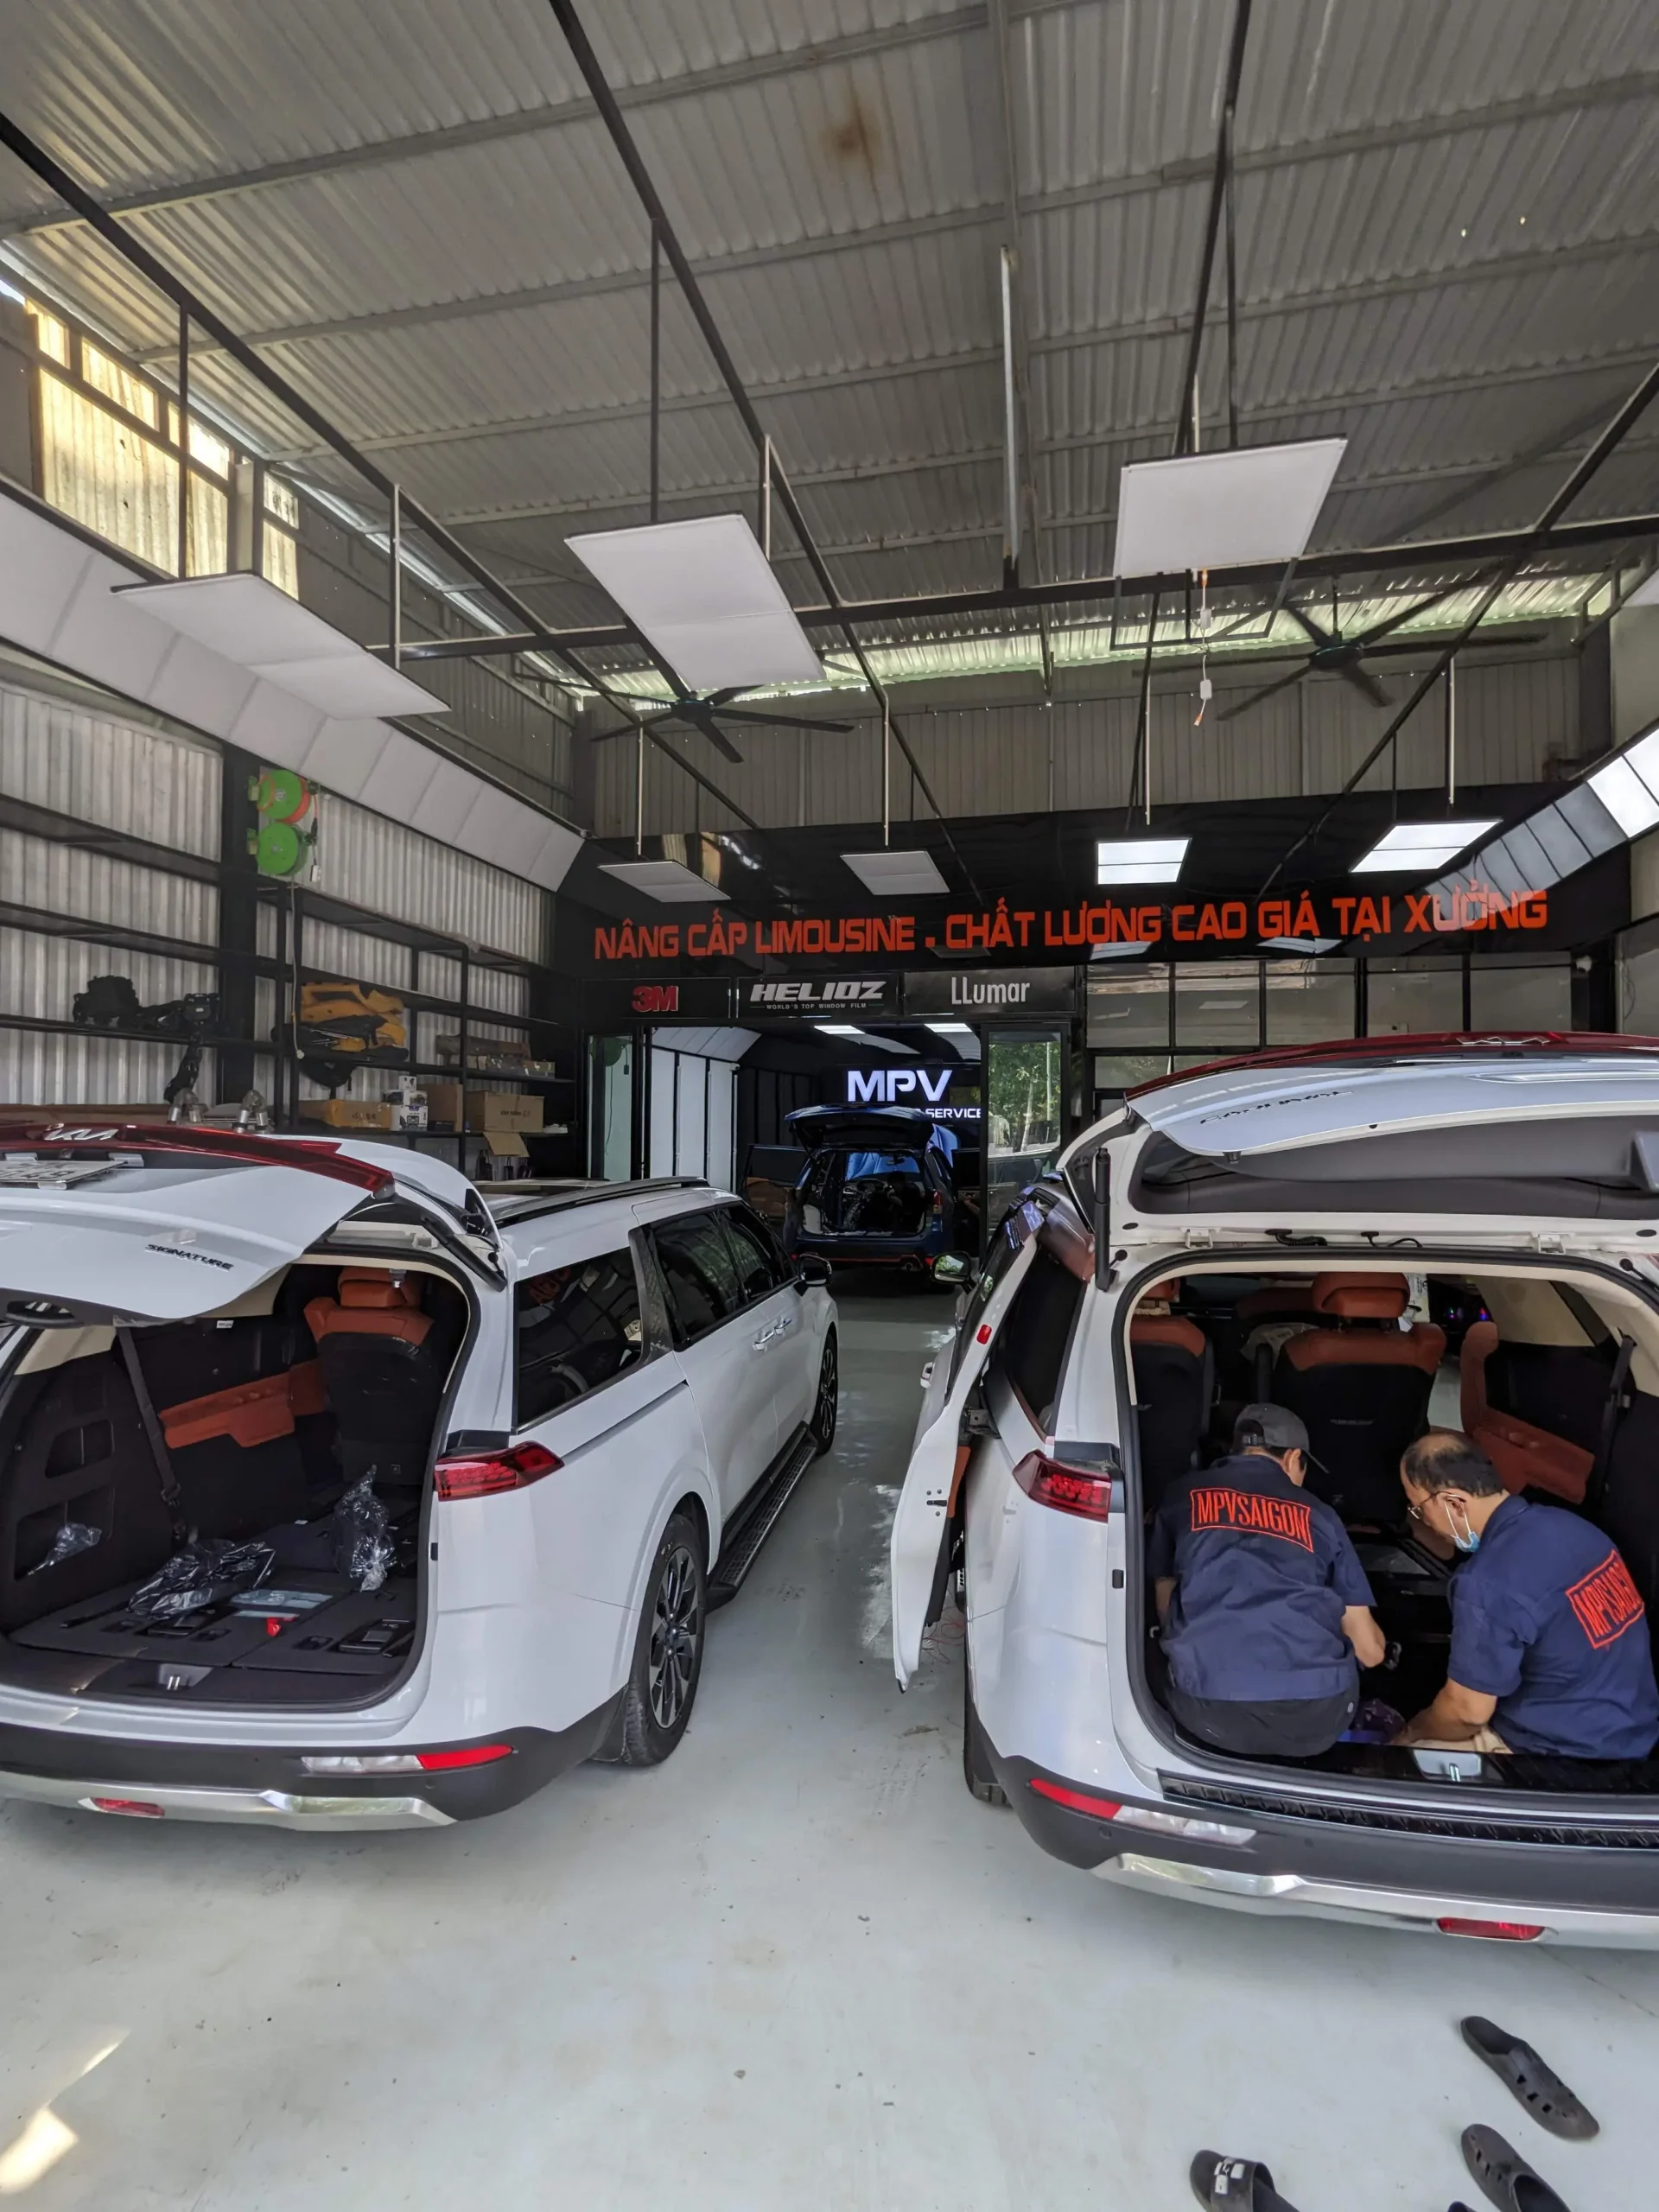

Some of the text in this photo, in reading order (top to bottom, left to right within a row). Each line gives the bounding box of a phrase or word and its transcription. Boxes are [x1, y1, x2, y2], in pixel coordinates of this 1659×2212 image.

[594, 918, 679, 960] NÂNG
[688, 907, 747, 957] CẤP
[755, 917, 915, 954] LIMOUSINE
[945, 896, 1036, 949] CHẤT
[1173, 901, 1247, 941] CAO
[1258, 889, 1320, 938] GIÁ
[1332, 896, 1391, 942] TẠI
[1403, 879, 1548, 932] XƯỞNG
[631, 985, 679, 1013] 3M
[749, 982, 887, 1002] HELIOZ
[951, 976, 1031, 1005] LLumar
[847, 1070, 953, 1103] MPV
[145, 1243, 234, 1271] SIGNATURE
[1196, 1491, 1309, 1545] MPVSAIGON
